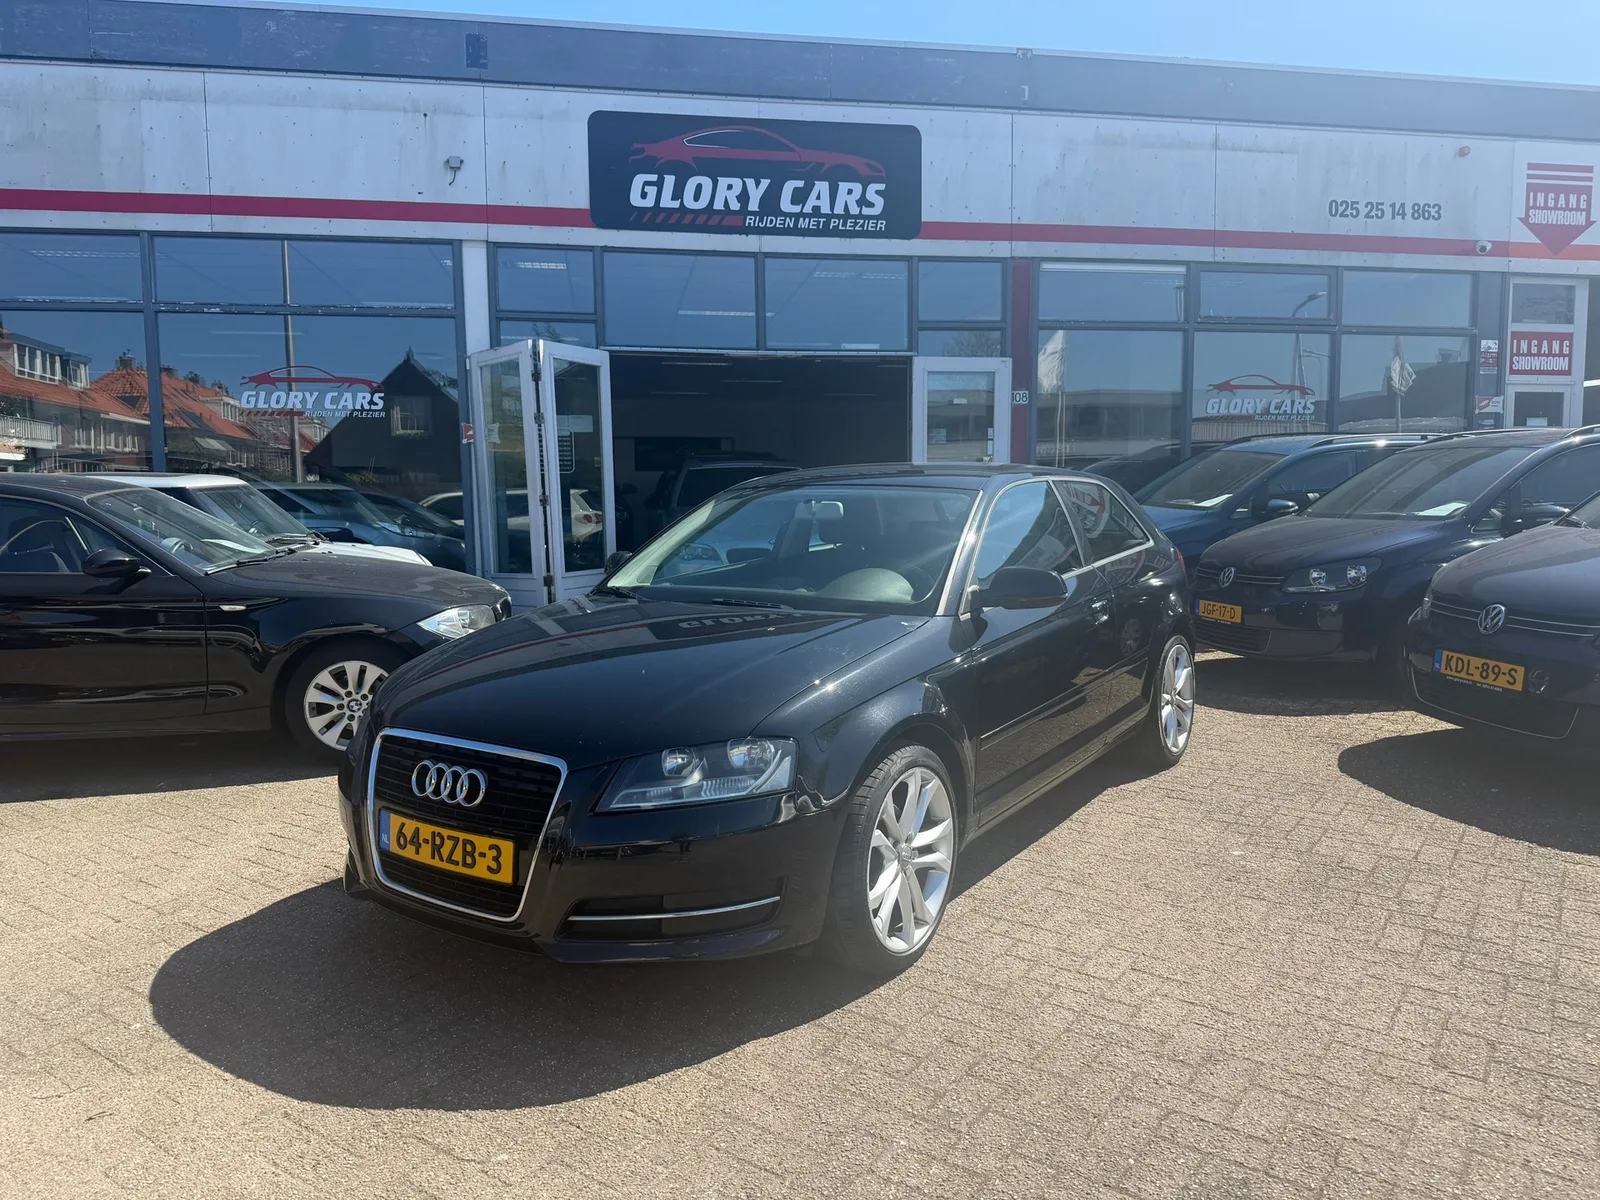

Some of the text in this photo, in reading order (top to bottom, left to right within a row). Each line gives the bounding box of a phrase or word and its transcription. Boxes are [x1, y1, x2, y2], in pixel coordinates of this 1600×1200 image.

[629, 173, 887, 216] GLORY CARS
[1529, 191, 1588, 209] INGANG
[1328, 199, 1442, 221] 025 25 14 863
[1528, 210, 1586, 226] SHOWROOM
[745, 216, 887, 231] RIJDEN MET PLEZIER
[1512, 339, 1570, 355] INGANG
[1512, 355, 1569, 371] SHOWROOM
[240, 390, 385, 410] GLORY CARS
[1012, 392, 1028, 403] 108
[1206, 398, 1316, 414] GLORY CARS
[1201, 602, 1236, 620] JGF-17-D
[1444, 654, 1518, 686] KDL-89-S
[381, 821, 503, 875] NL 64-RZB-3
